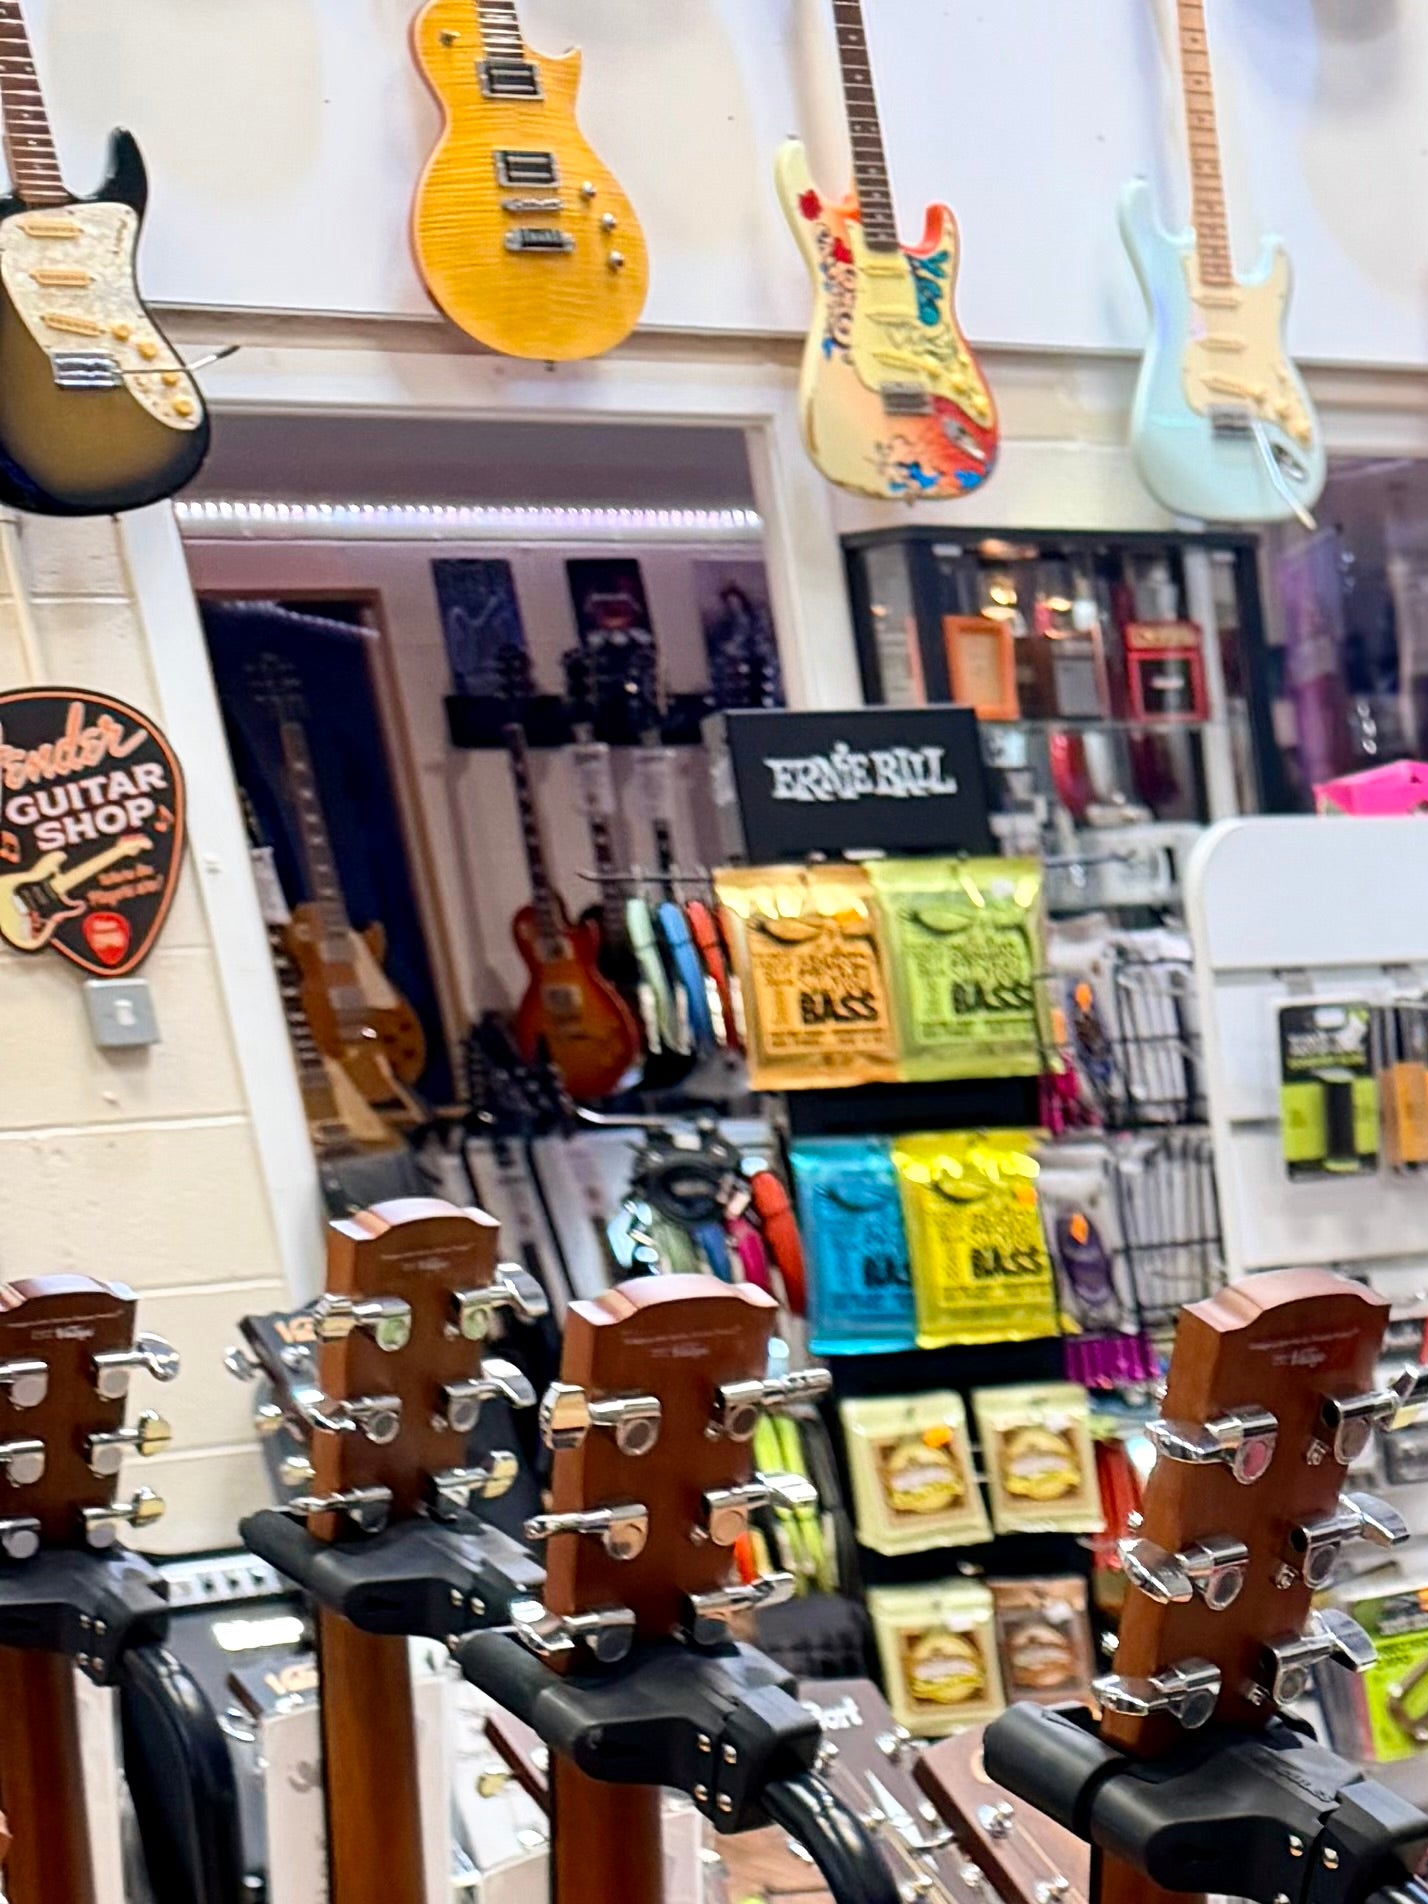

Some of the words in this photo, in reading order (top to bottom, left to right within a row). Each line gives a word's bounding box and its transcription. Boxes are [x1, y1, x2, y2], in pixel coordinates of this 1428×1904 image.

[0, 701, 149, 790] ender
[5, 762, 169, 825] GUITAR
[33, 797, 156, 851] SHOP
[799, 990, 879, 1025] BASS
